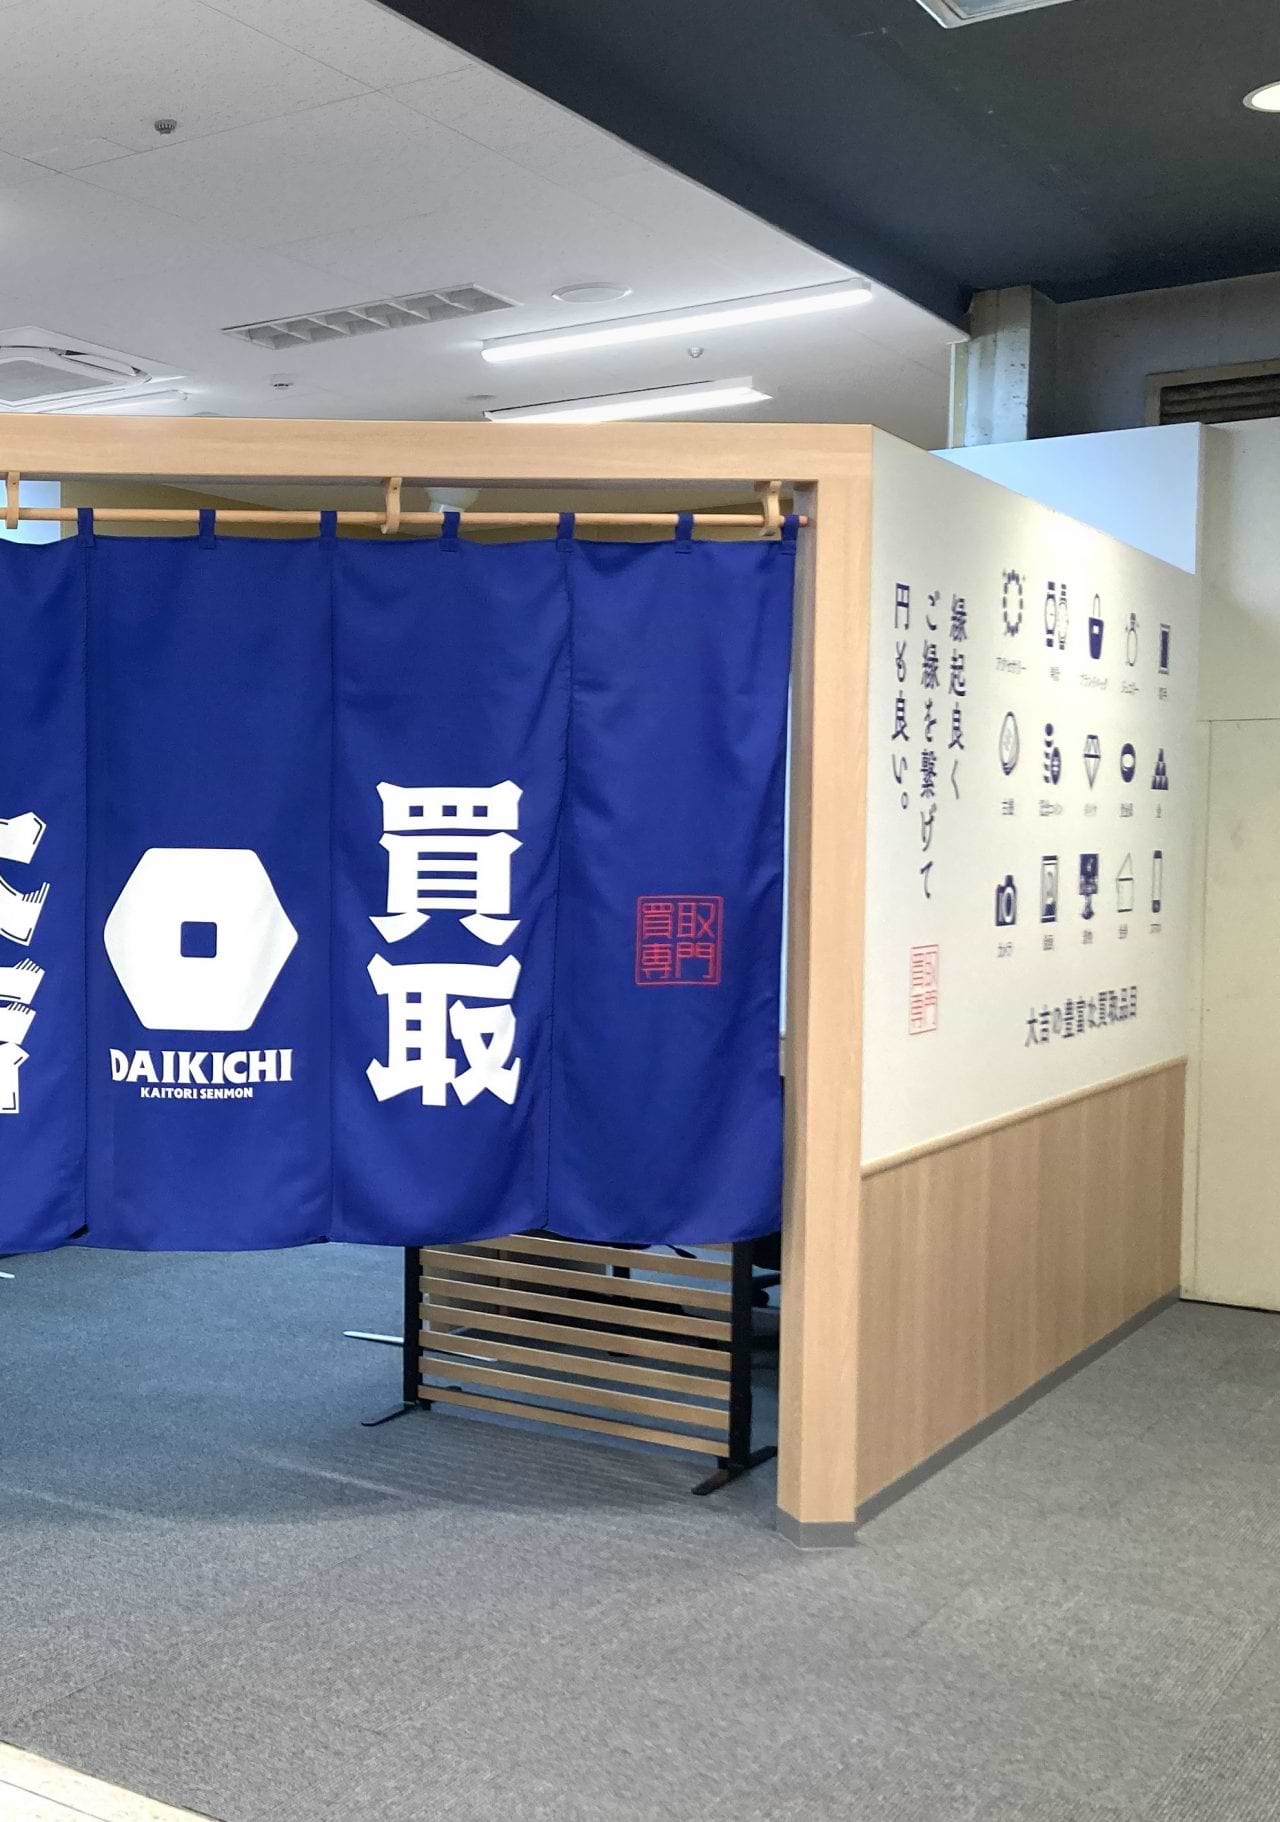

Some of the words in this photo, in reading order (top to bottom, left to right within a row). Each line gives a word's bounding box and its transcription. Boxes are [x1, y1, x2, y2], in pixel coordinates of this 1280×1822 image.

[891, 583, 911, 810] 円も良い。
[948, 594, 968, 800] 縁起良く
[366, 779, 524, 1107] 買取
[110, 1048, 293, 1084] DAIKICHI
[140, 1087, 198, 1099] KAITORI
[200, 1087, 253, 1099] SENMON
